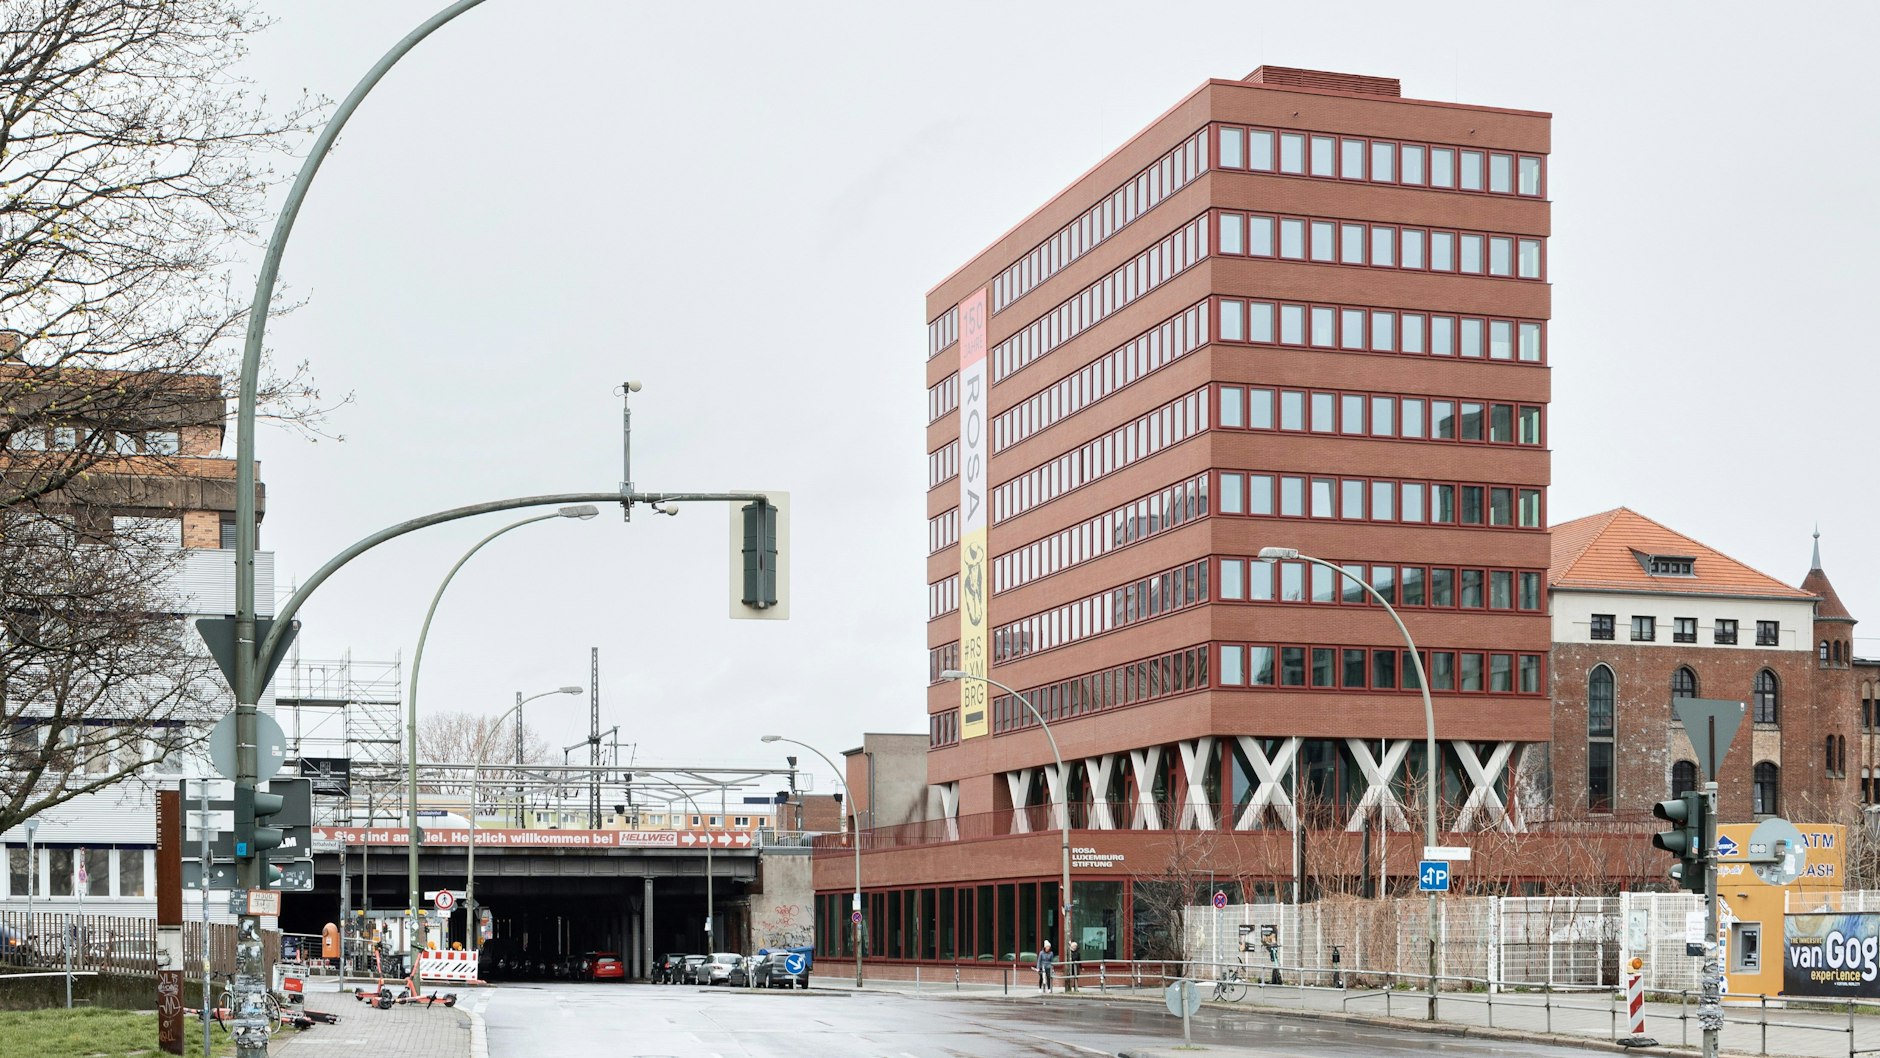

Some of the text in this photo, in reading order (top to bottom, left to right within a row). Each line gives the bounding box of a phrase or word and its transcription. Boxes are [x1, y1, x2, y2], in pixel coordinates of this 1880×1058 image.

[963, 302, 983, 337] 150
[963, 334, 983, 359] JAHRE
[967, 374, 980, 521] ROSA
[965, 636, 982, 660] #RS
[965, 659, 983, 684] LXM
[965, 683, 984, 708] BRG
[334, 831, 356, 842] Sie
[360, 831, 389, 843] sind
[451, 832, 507, 844] Hezlich
[510, 832, 590, 844] willkommen
[593, 833, 613, 844] bei
[621, 833, 675, 842] HELLWEG
[1435, 869, 1447, 886] P
[1790, 930, 1880, 982] van Gog
[1810, 968, 1861, 985] experience
